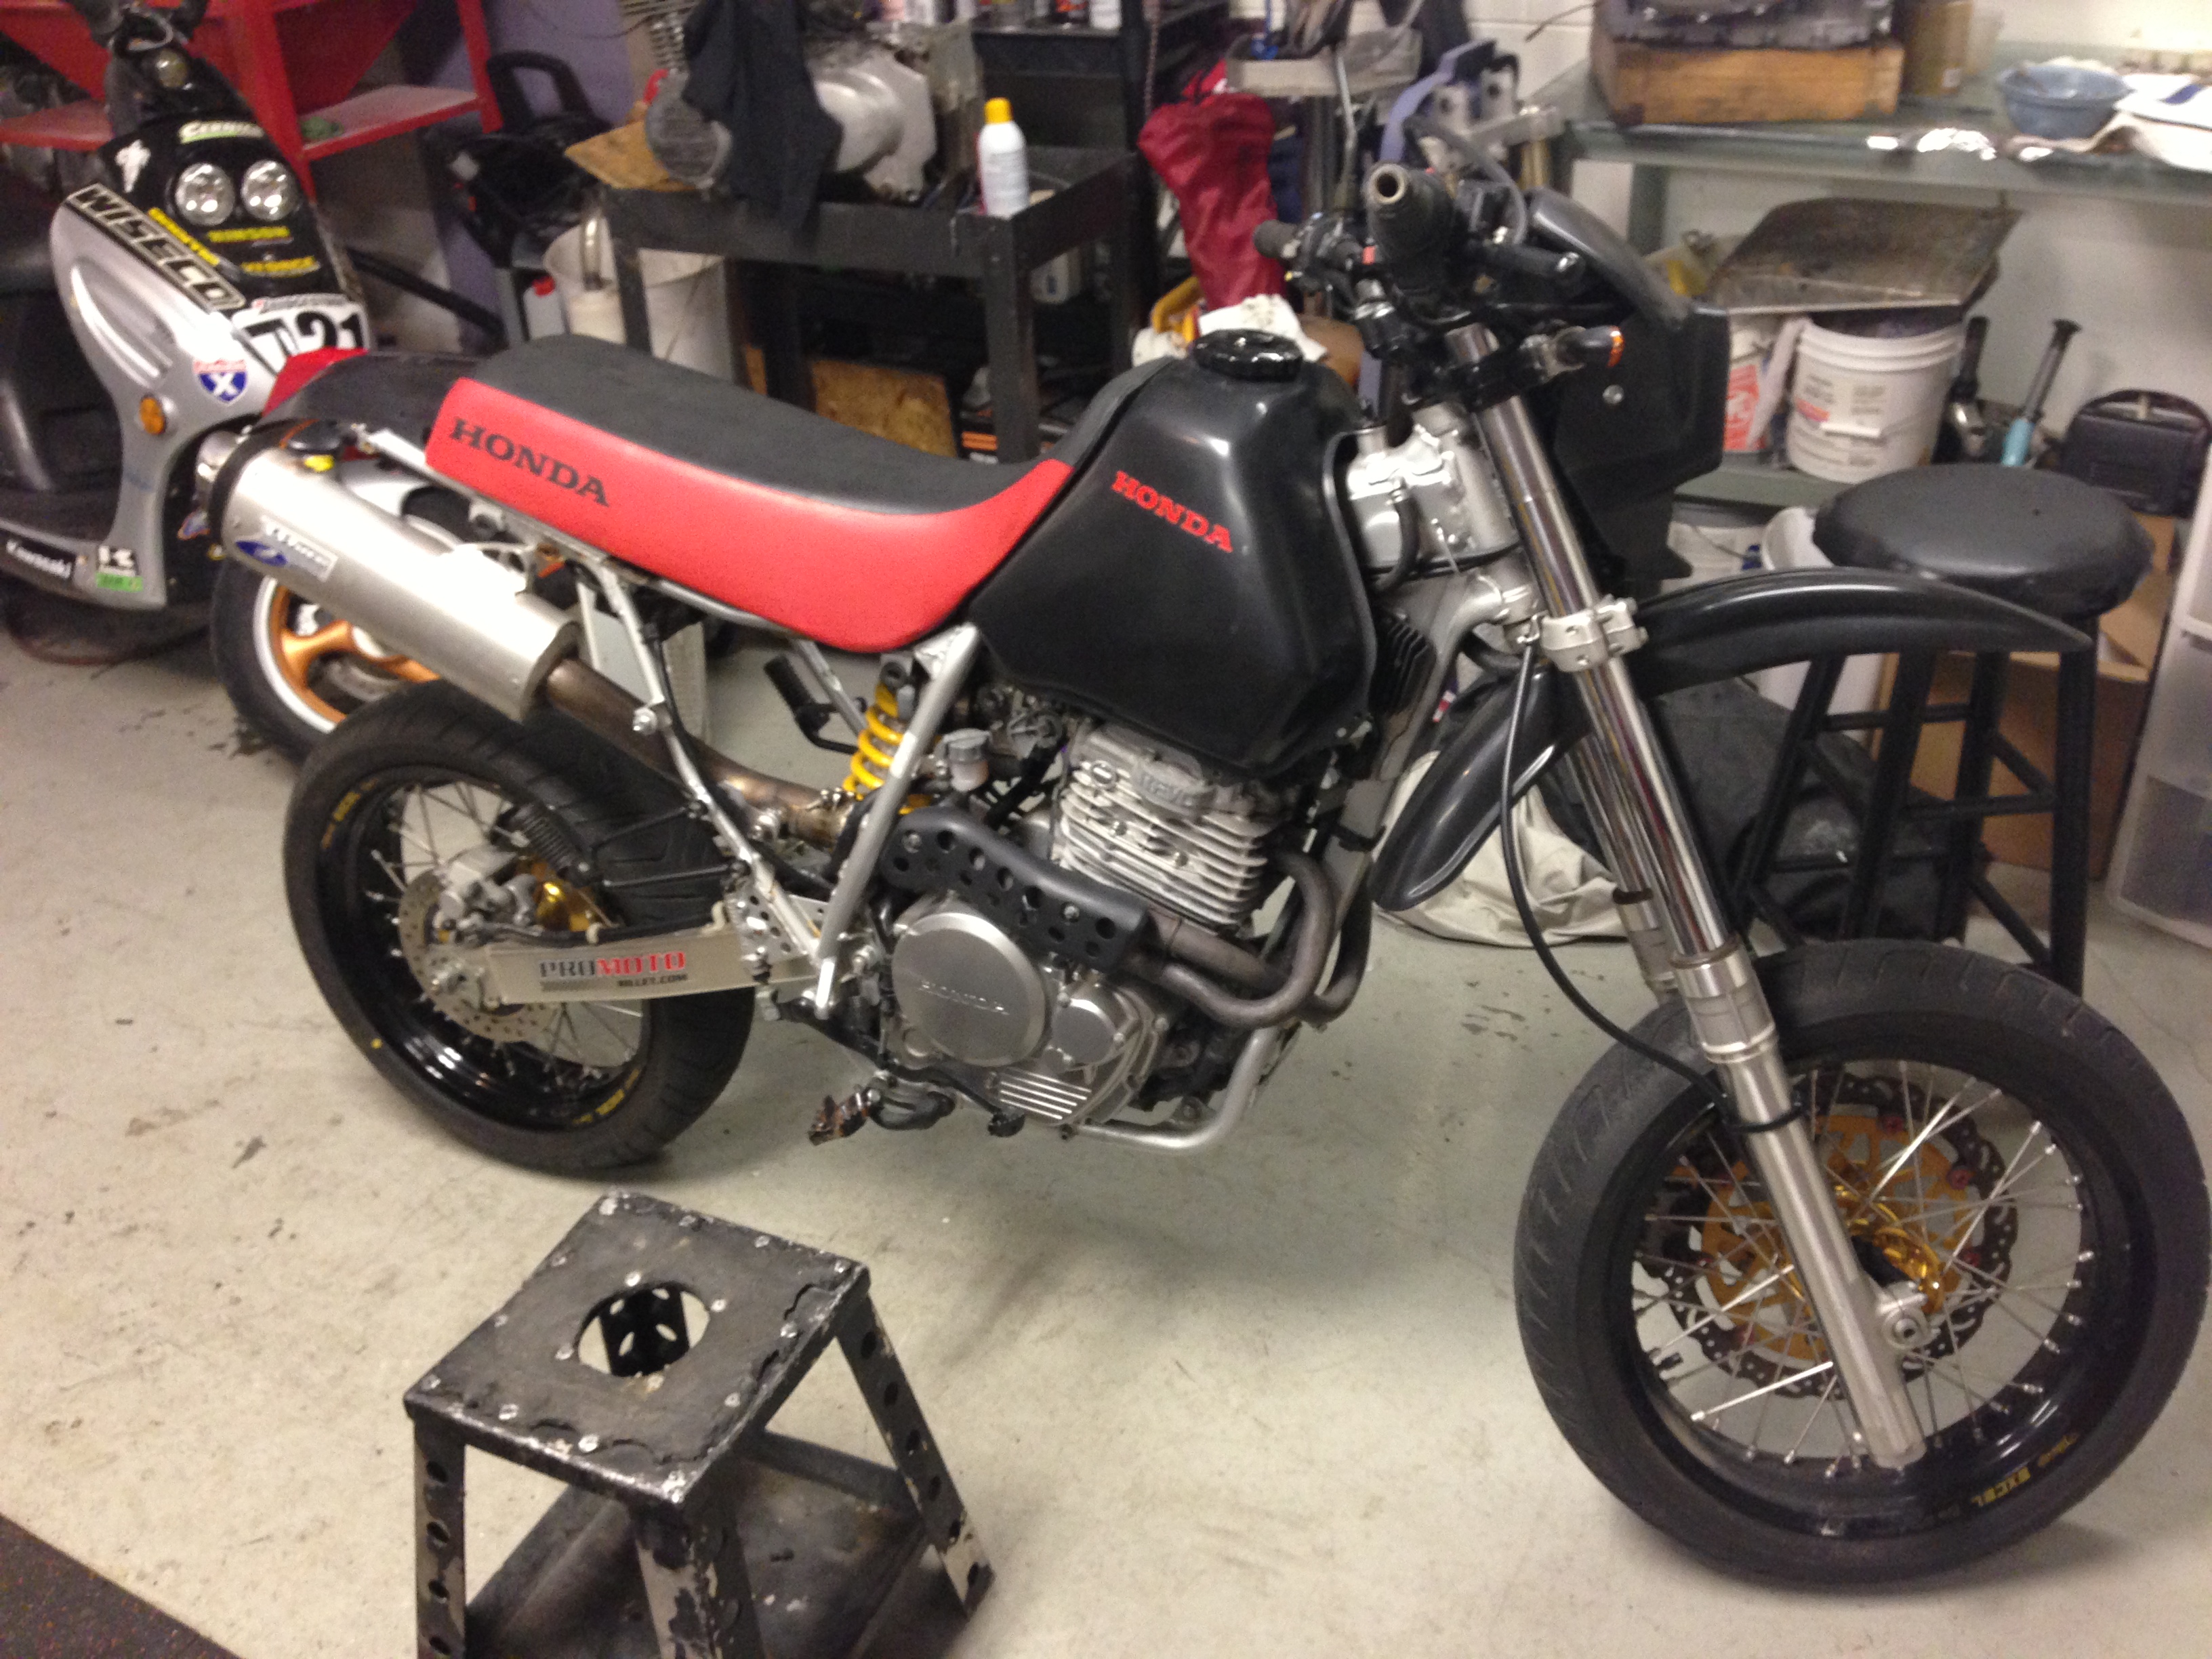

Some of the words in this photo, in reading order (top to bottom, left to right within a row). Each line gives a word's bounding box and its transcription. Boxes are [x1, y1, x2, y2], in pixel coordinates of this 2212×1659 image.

[75, 188, 239, 306] WISECO
[449, 417, 609, 508] HONDA
[1111, 470, 1233, 554] HONDA
